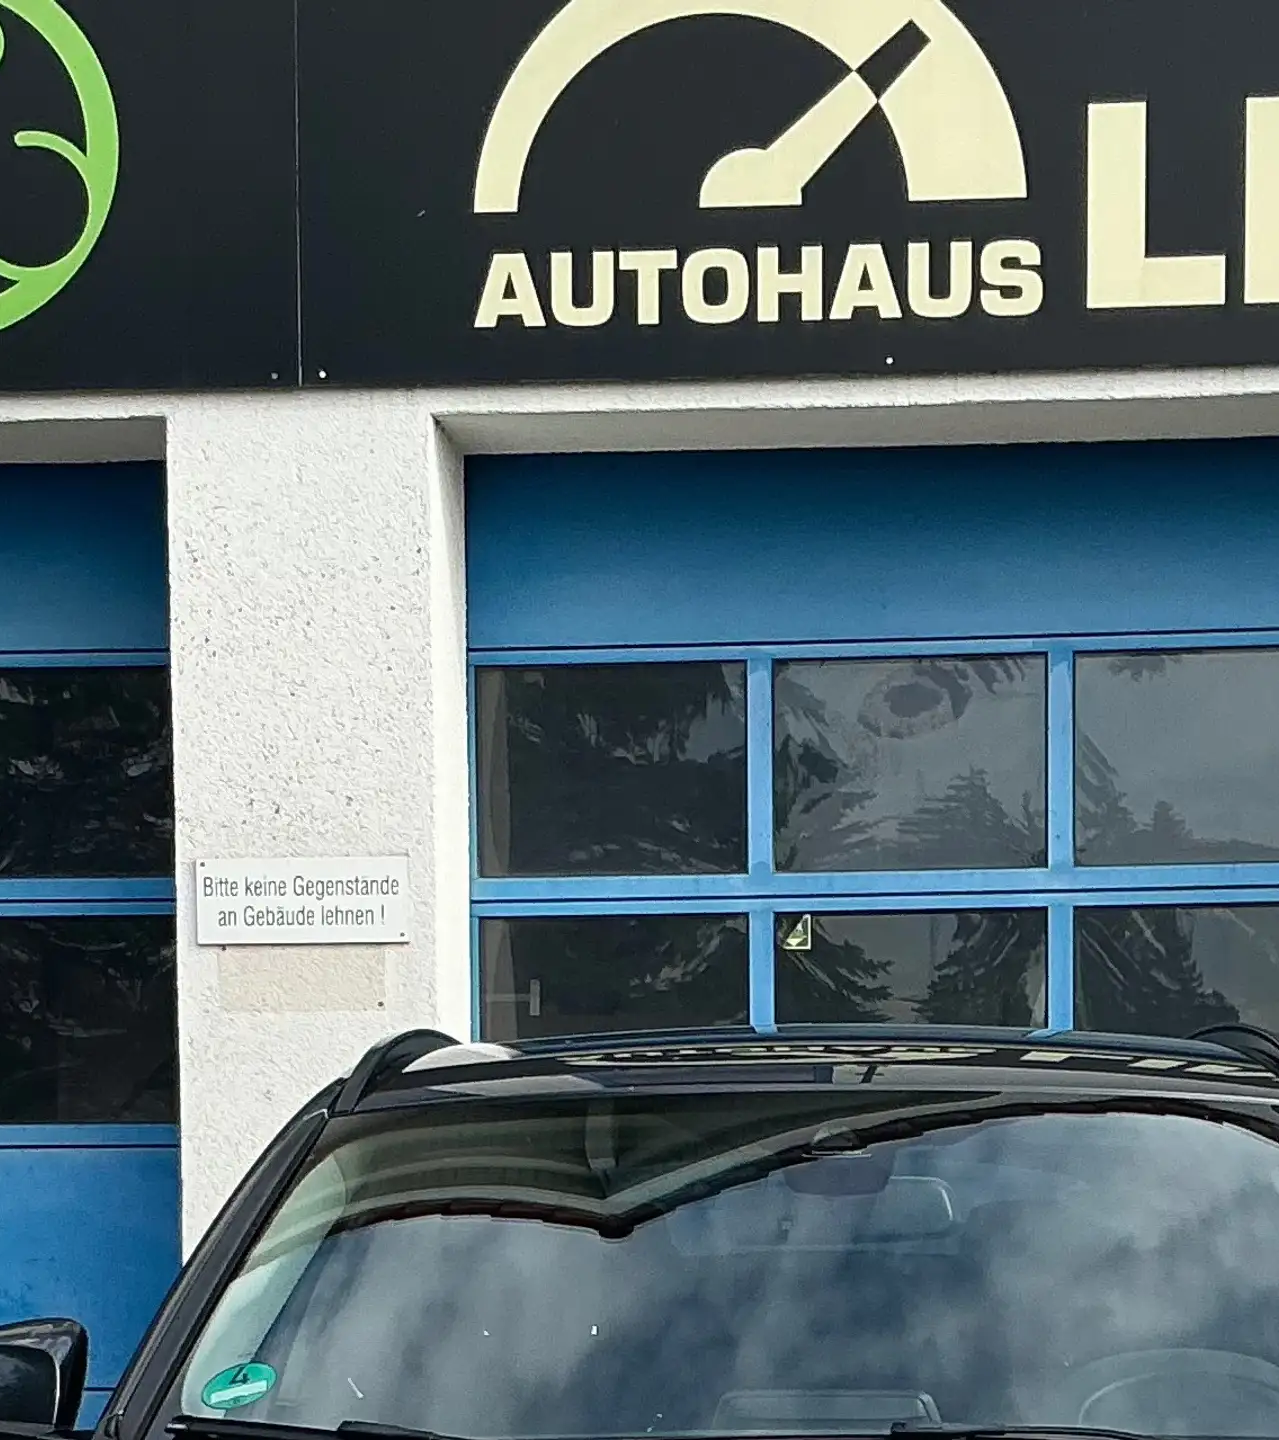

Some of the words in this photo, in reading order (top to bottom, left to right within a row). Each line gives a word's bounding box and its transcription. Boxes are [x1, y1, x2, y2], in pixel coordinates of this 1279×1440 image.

[474, 239, 1043, 327] AUTOHAUS
[203, 876, 238, 897] Bitte
[245, 876, 287, 896] keine
[293, 875, 399, 901] Gegenstände
[218, 911, 237, 926] an
[243, 905, 315, 926] Gebäude
[321, 906, 375, 925] lehnen
